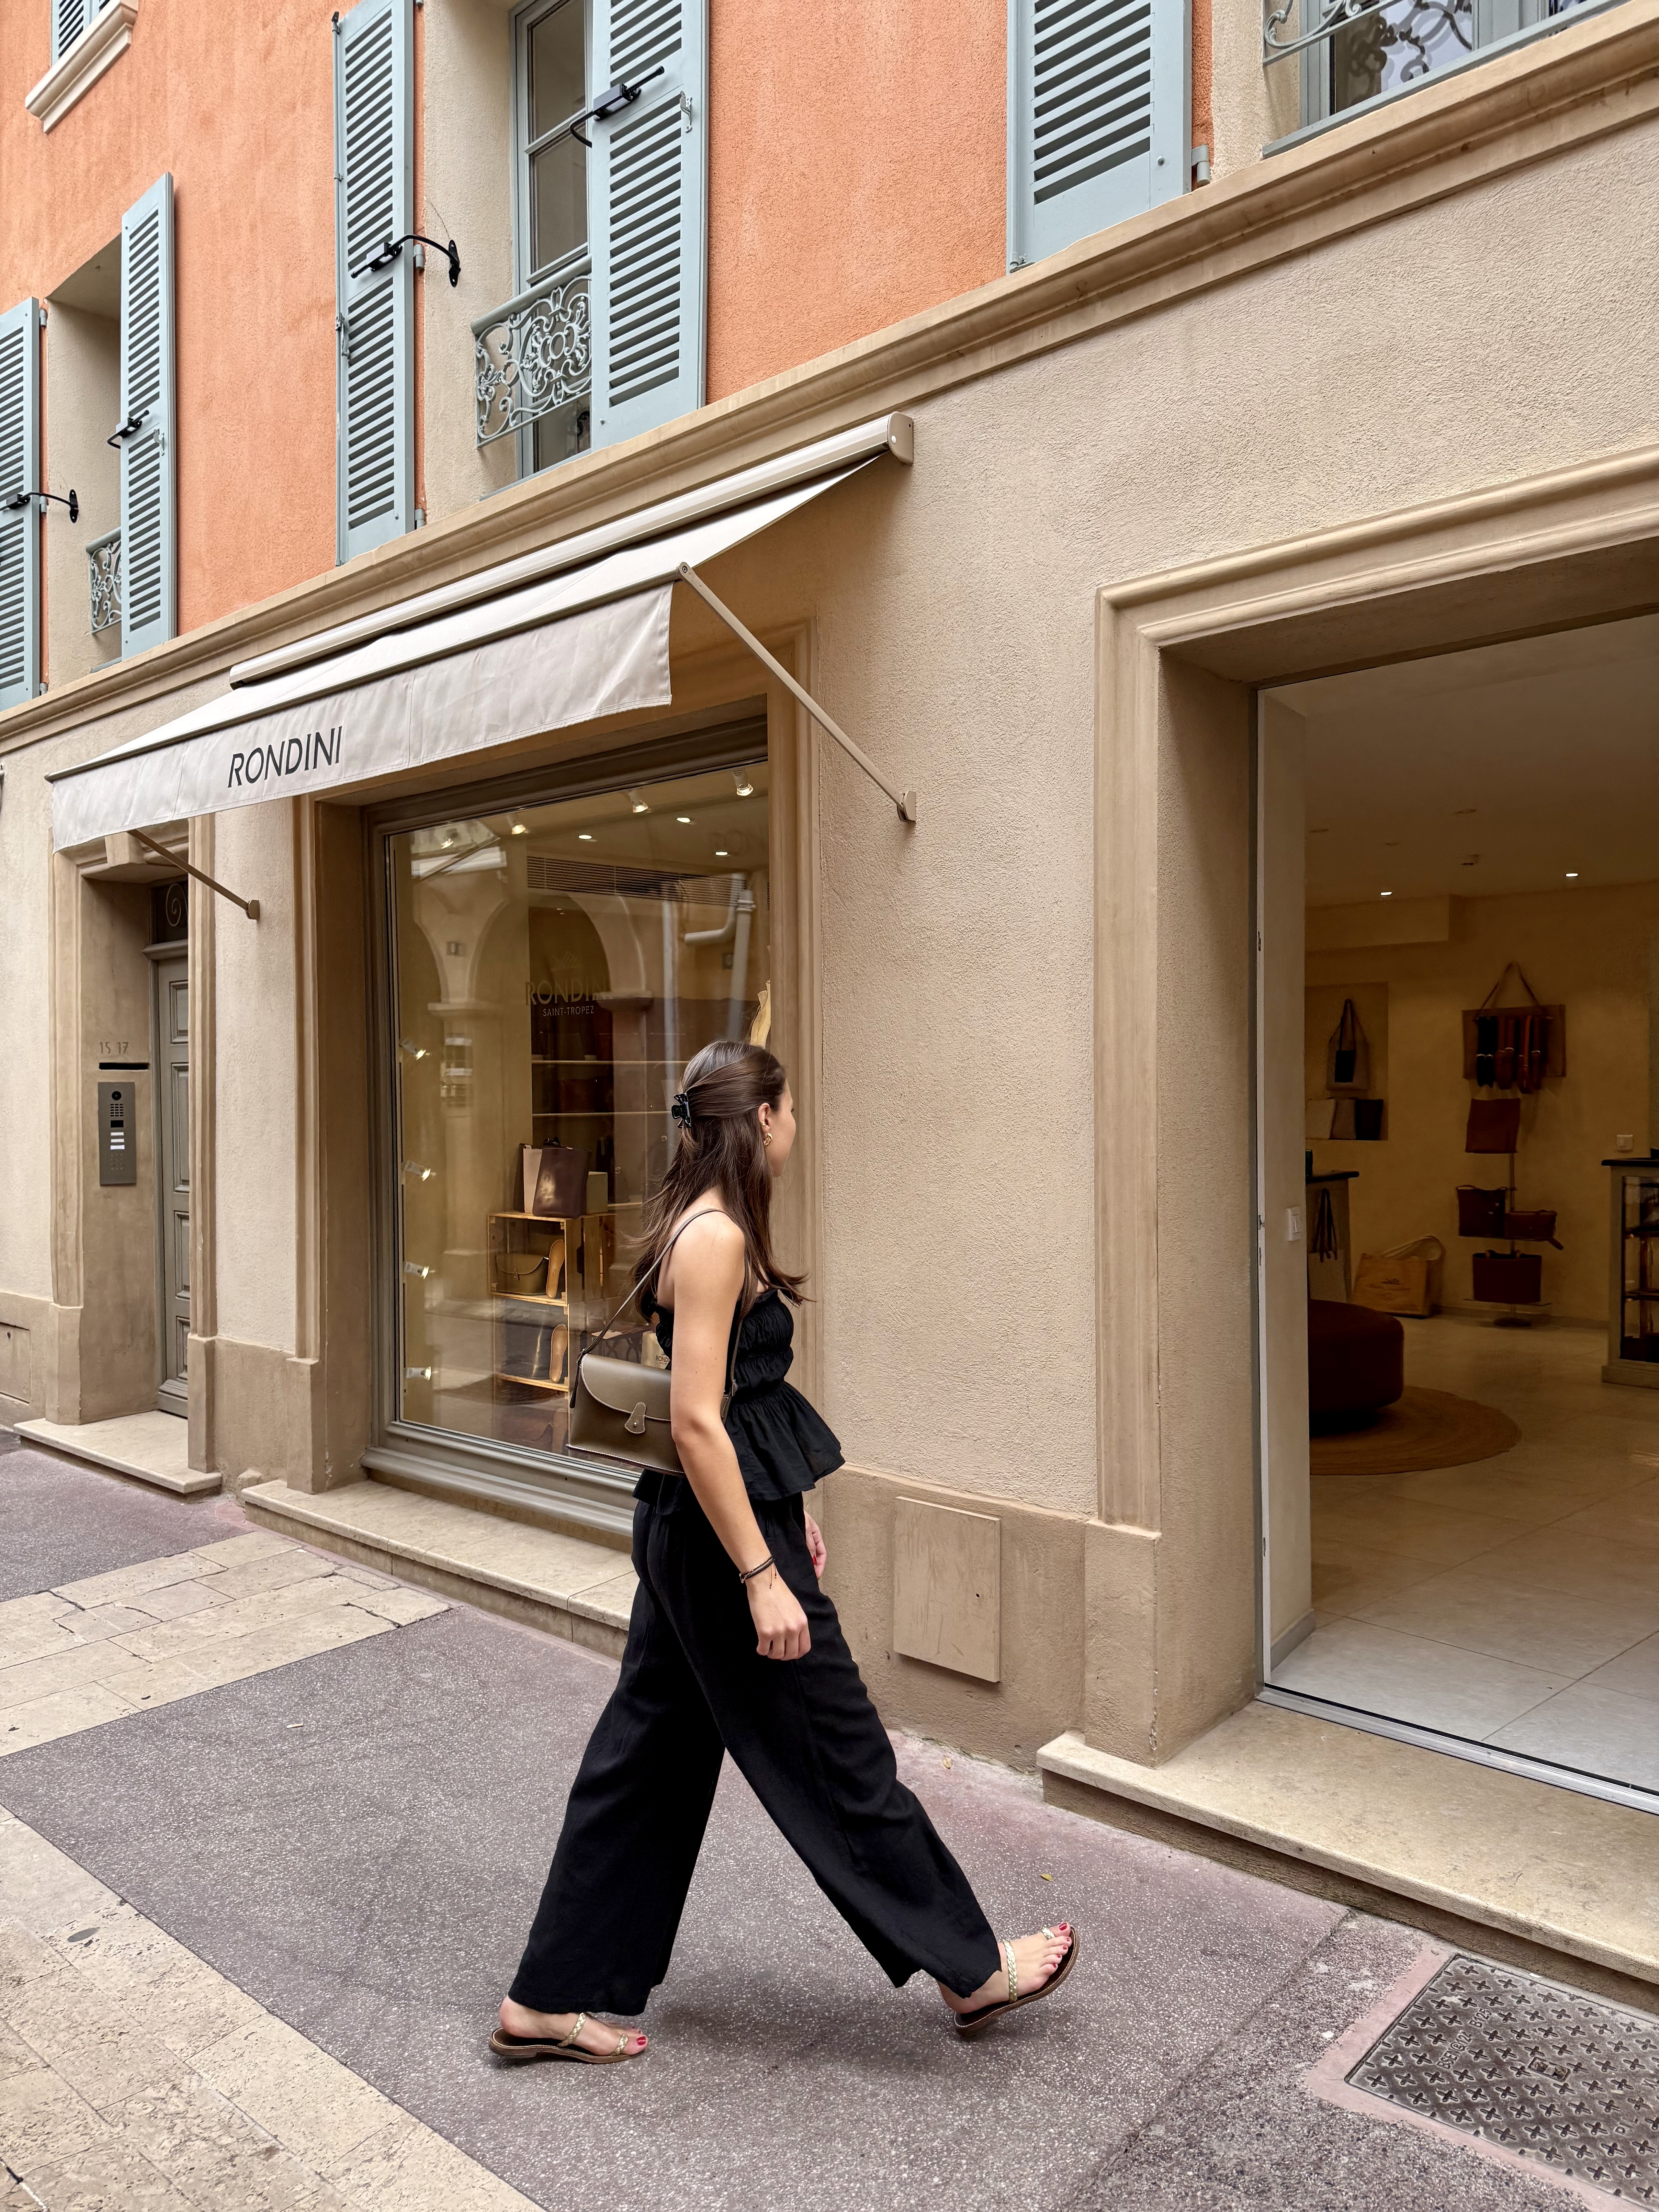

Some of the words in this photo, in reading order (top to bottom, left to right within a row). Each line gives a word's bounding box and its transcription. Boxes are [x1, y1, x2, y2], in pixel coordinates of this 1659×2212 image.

[228, 726, 342, 788] RONDINI
[526, 976, 613, 1005] RONDIN
[543, 1006, 594, 1017] SAINT-TROPEZ
[99, 1042, 111, 1054] 15
[117, 1042, 129, 1054] 17
[1468, 2008, 1492, 2028] B125
